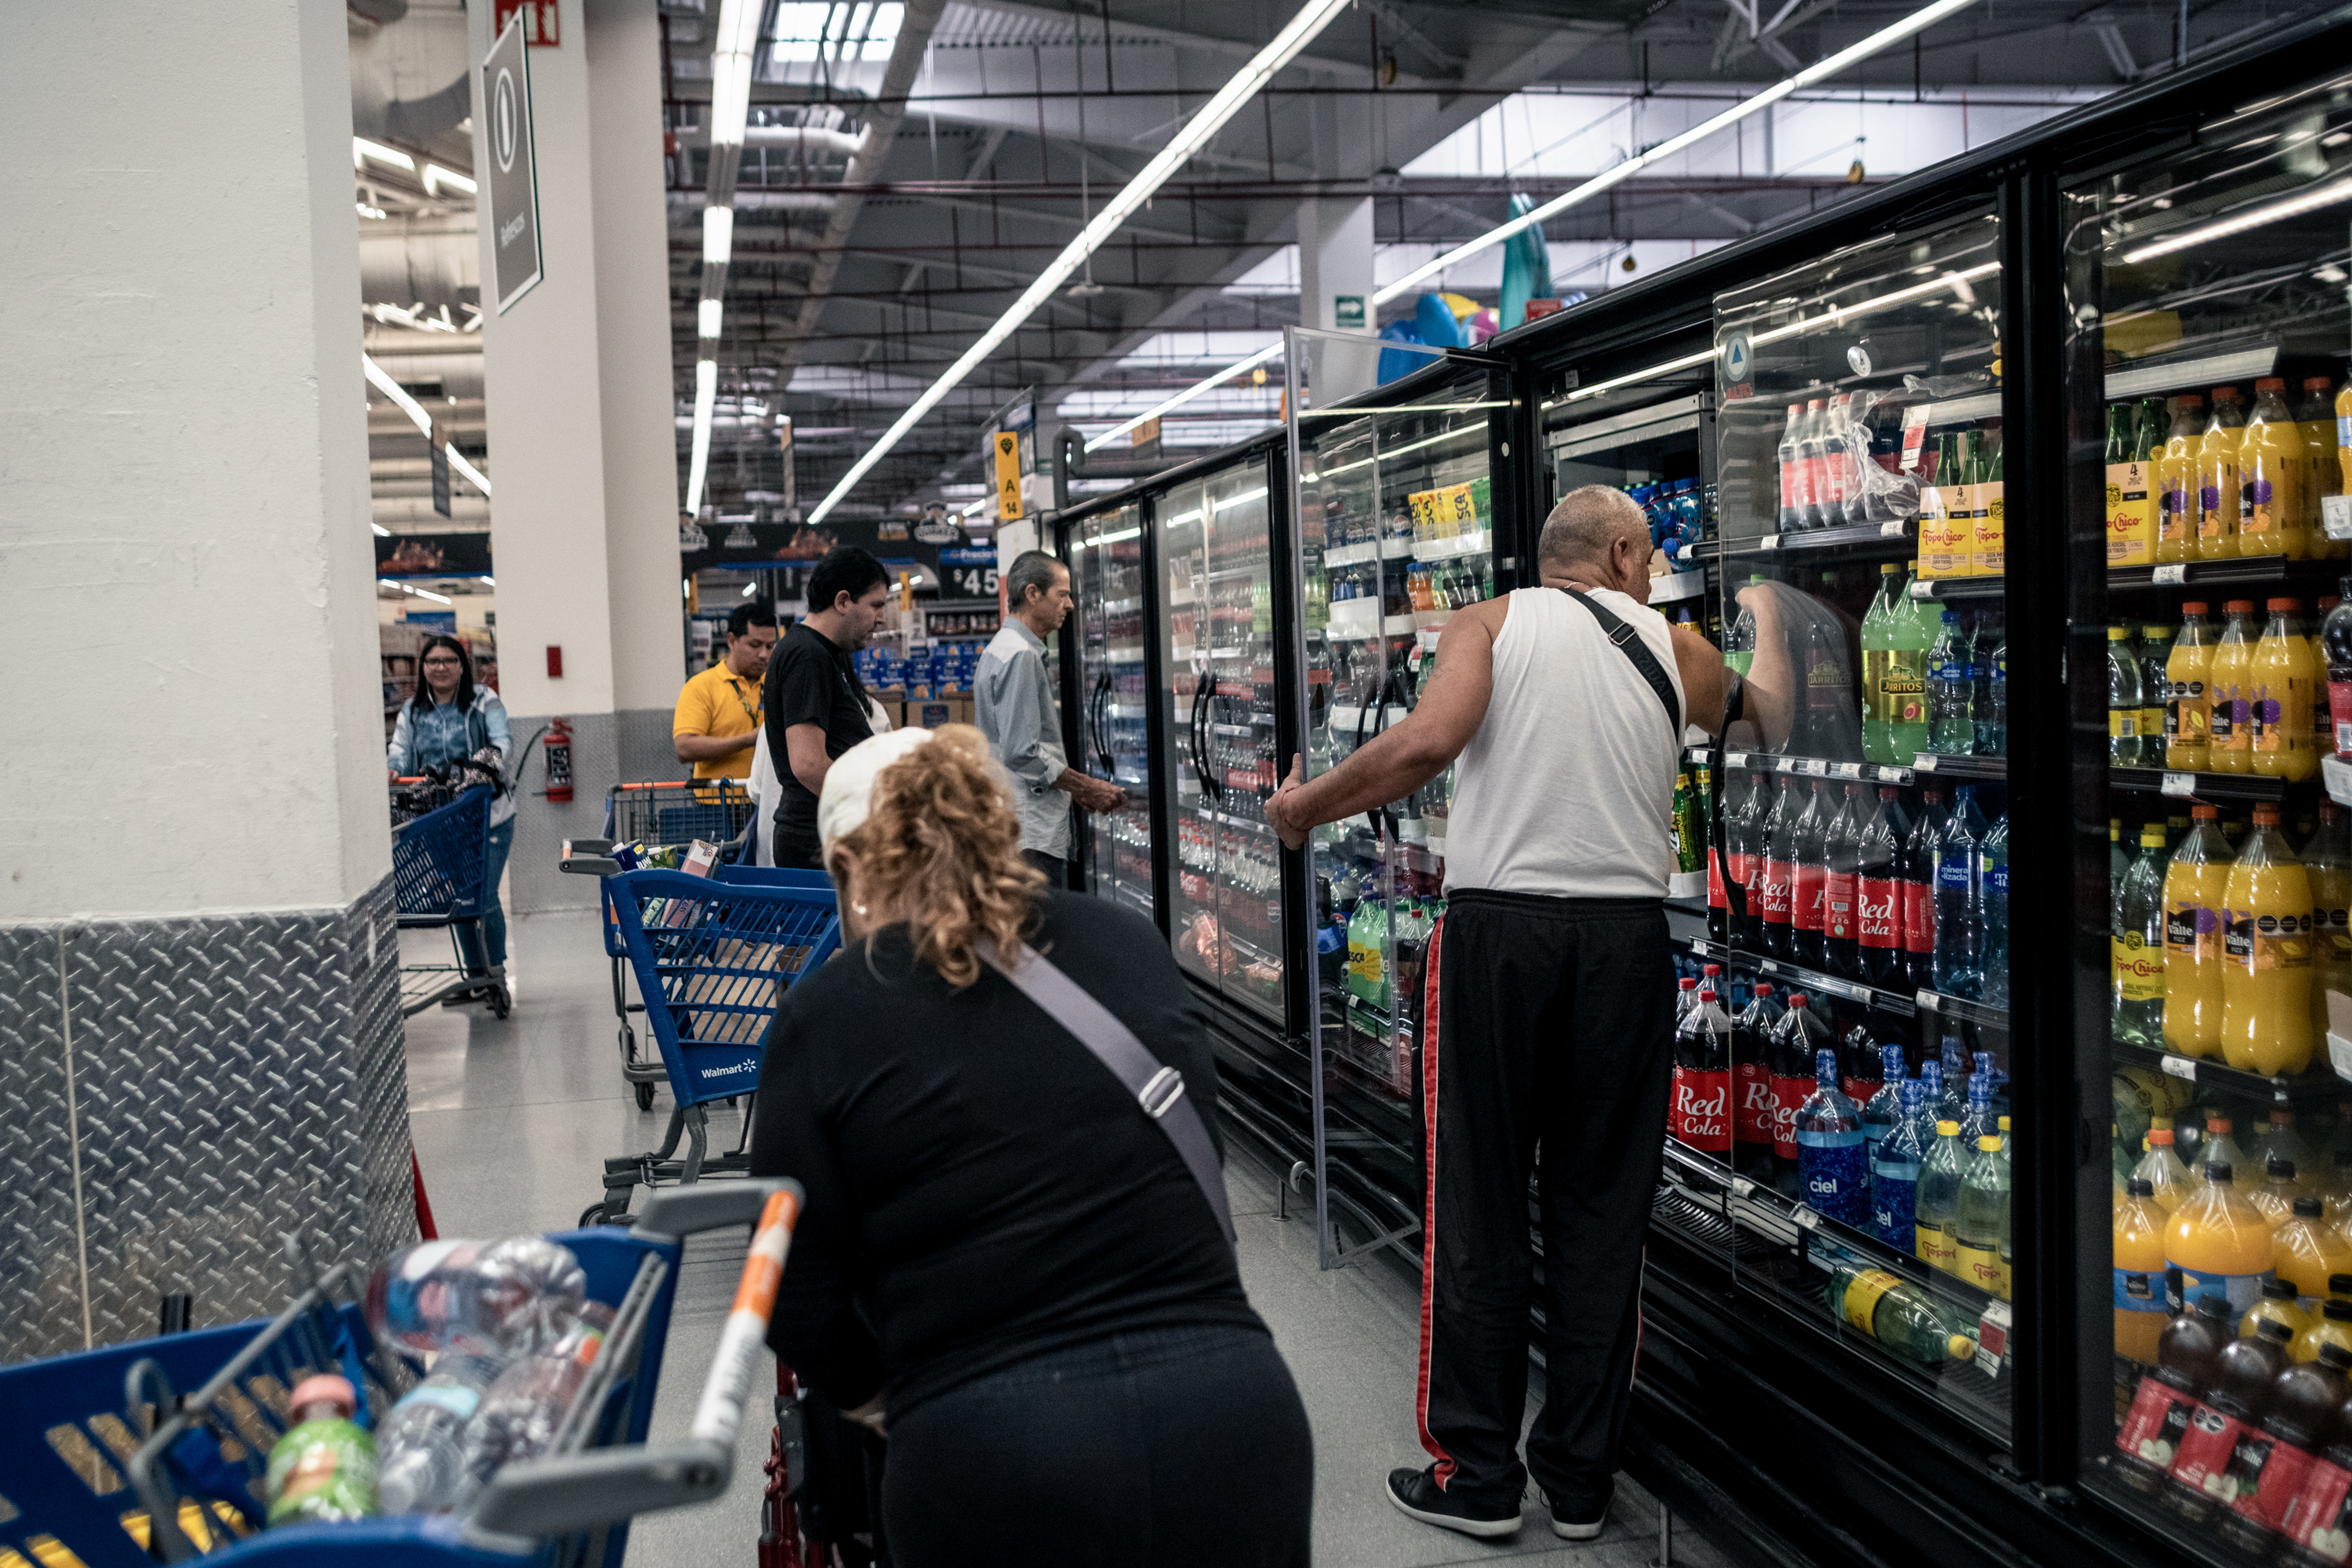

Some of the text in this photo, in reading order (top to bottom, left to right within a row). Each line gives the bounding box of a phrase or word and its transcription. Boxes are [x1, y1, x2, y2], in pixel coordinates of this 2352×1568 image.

[2130, 463, 2138, 476] 4
[1005, 479, 1015, 492] A
[1957, 486, 1964, 497] 4
[1005, 502, 1017, 514] 14
[2114, 513, 2142, 532] Chico
[1922, 529, 1966, 546] Topo Chico
[1975, 527, 2000, 544] Topo
[1678, 810, 1688, 853] ORIGINAL
[1941, 864, 1969, 874] minera
[1763, 874, 1792, 898] Red
[1764, 897, 1788, 912] Cola
[1859, 894, 1895, 920] Red
[1861, 920, 1890, 935] Cola
[2167, 924, 2193, 936] Valle
[2226, 934, 2250, 947] Valle
[701, 1063, 743, 1079] Walmart
[1677, 1084, 1727, 1116] Red
[1684, 1116, 1722, 1136] Cola
[1774, 1124, 1798, 1144] Col
[1809, 1176, 1838, 1194] ciel
